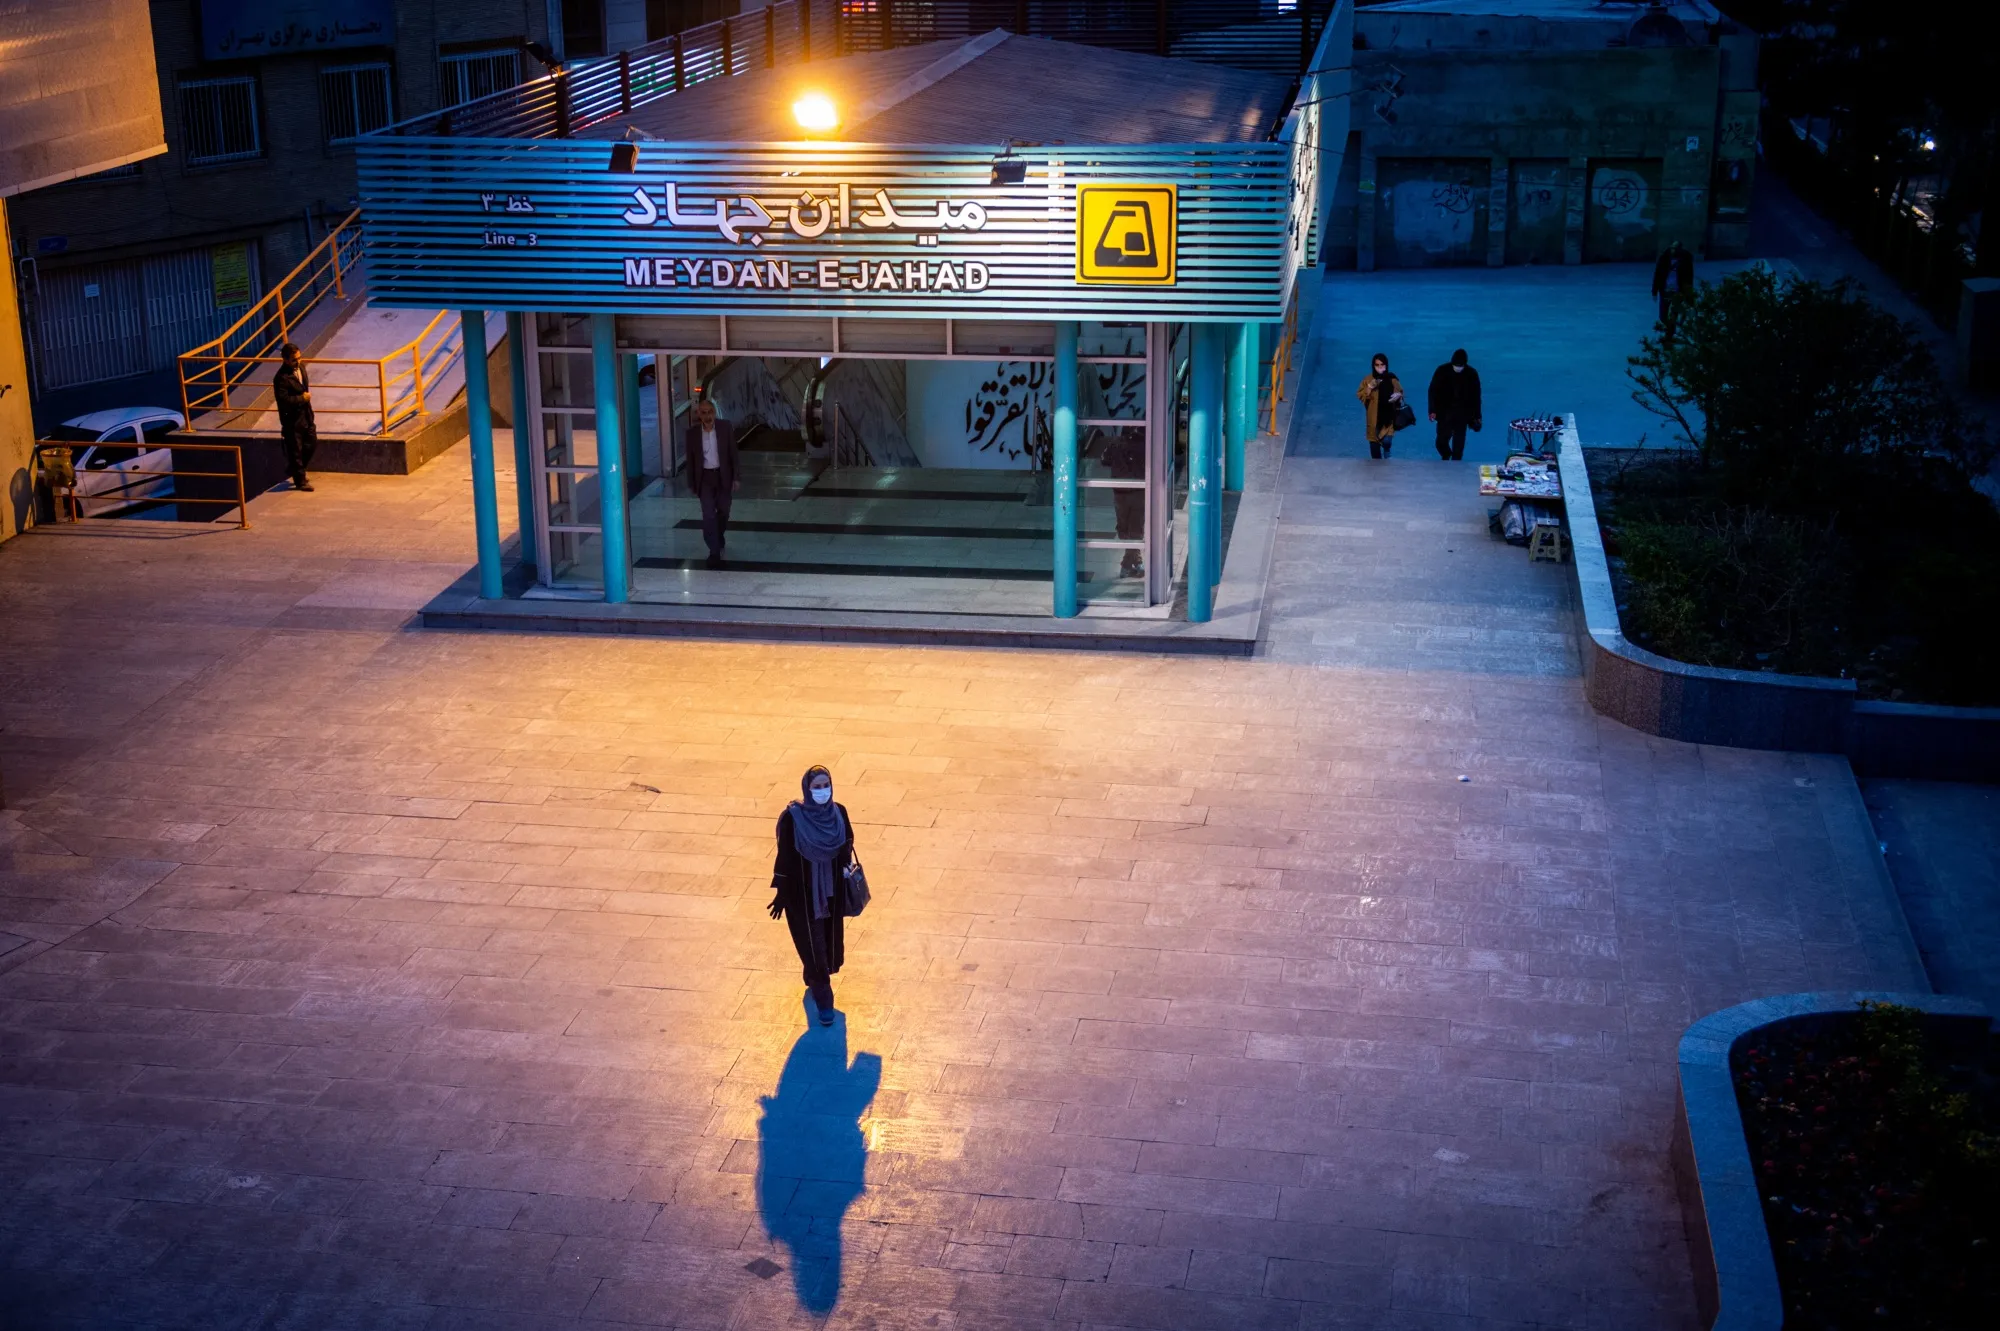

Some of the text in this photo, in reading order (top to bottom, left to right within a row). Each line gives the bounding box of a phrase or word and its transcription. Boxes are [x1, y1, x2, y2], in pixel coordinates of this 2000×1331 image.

[505, 195, 535, 212] خط
[623, 180, 988, 248] میدان جهاد
[484, 231, 538, 246] Line 3
[849, 259, 990, 293] JAHAD
